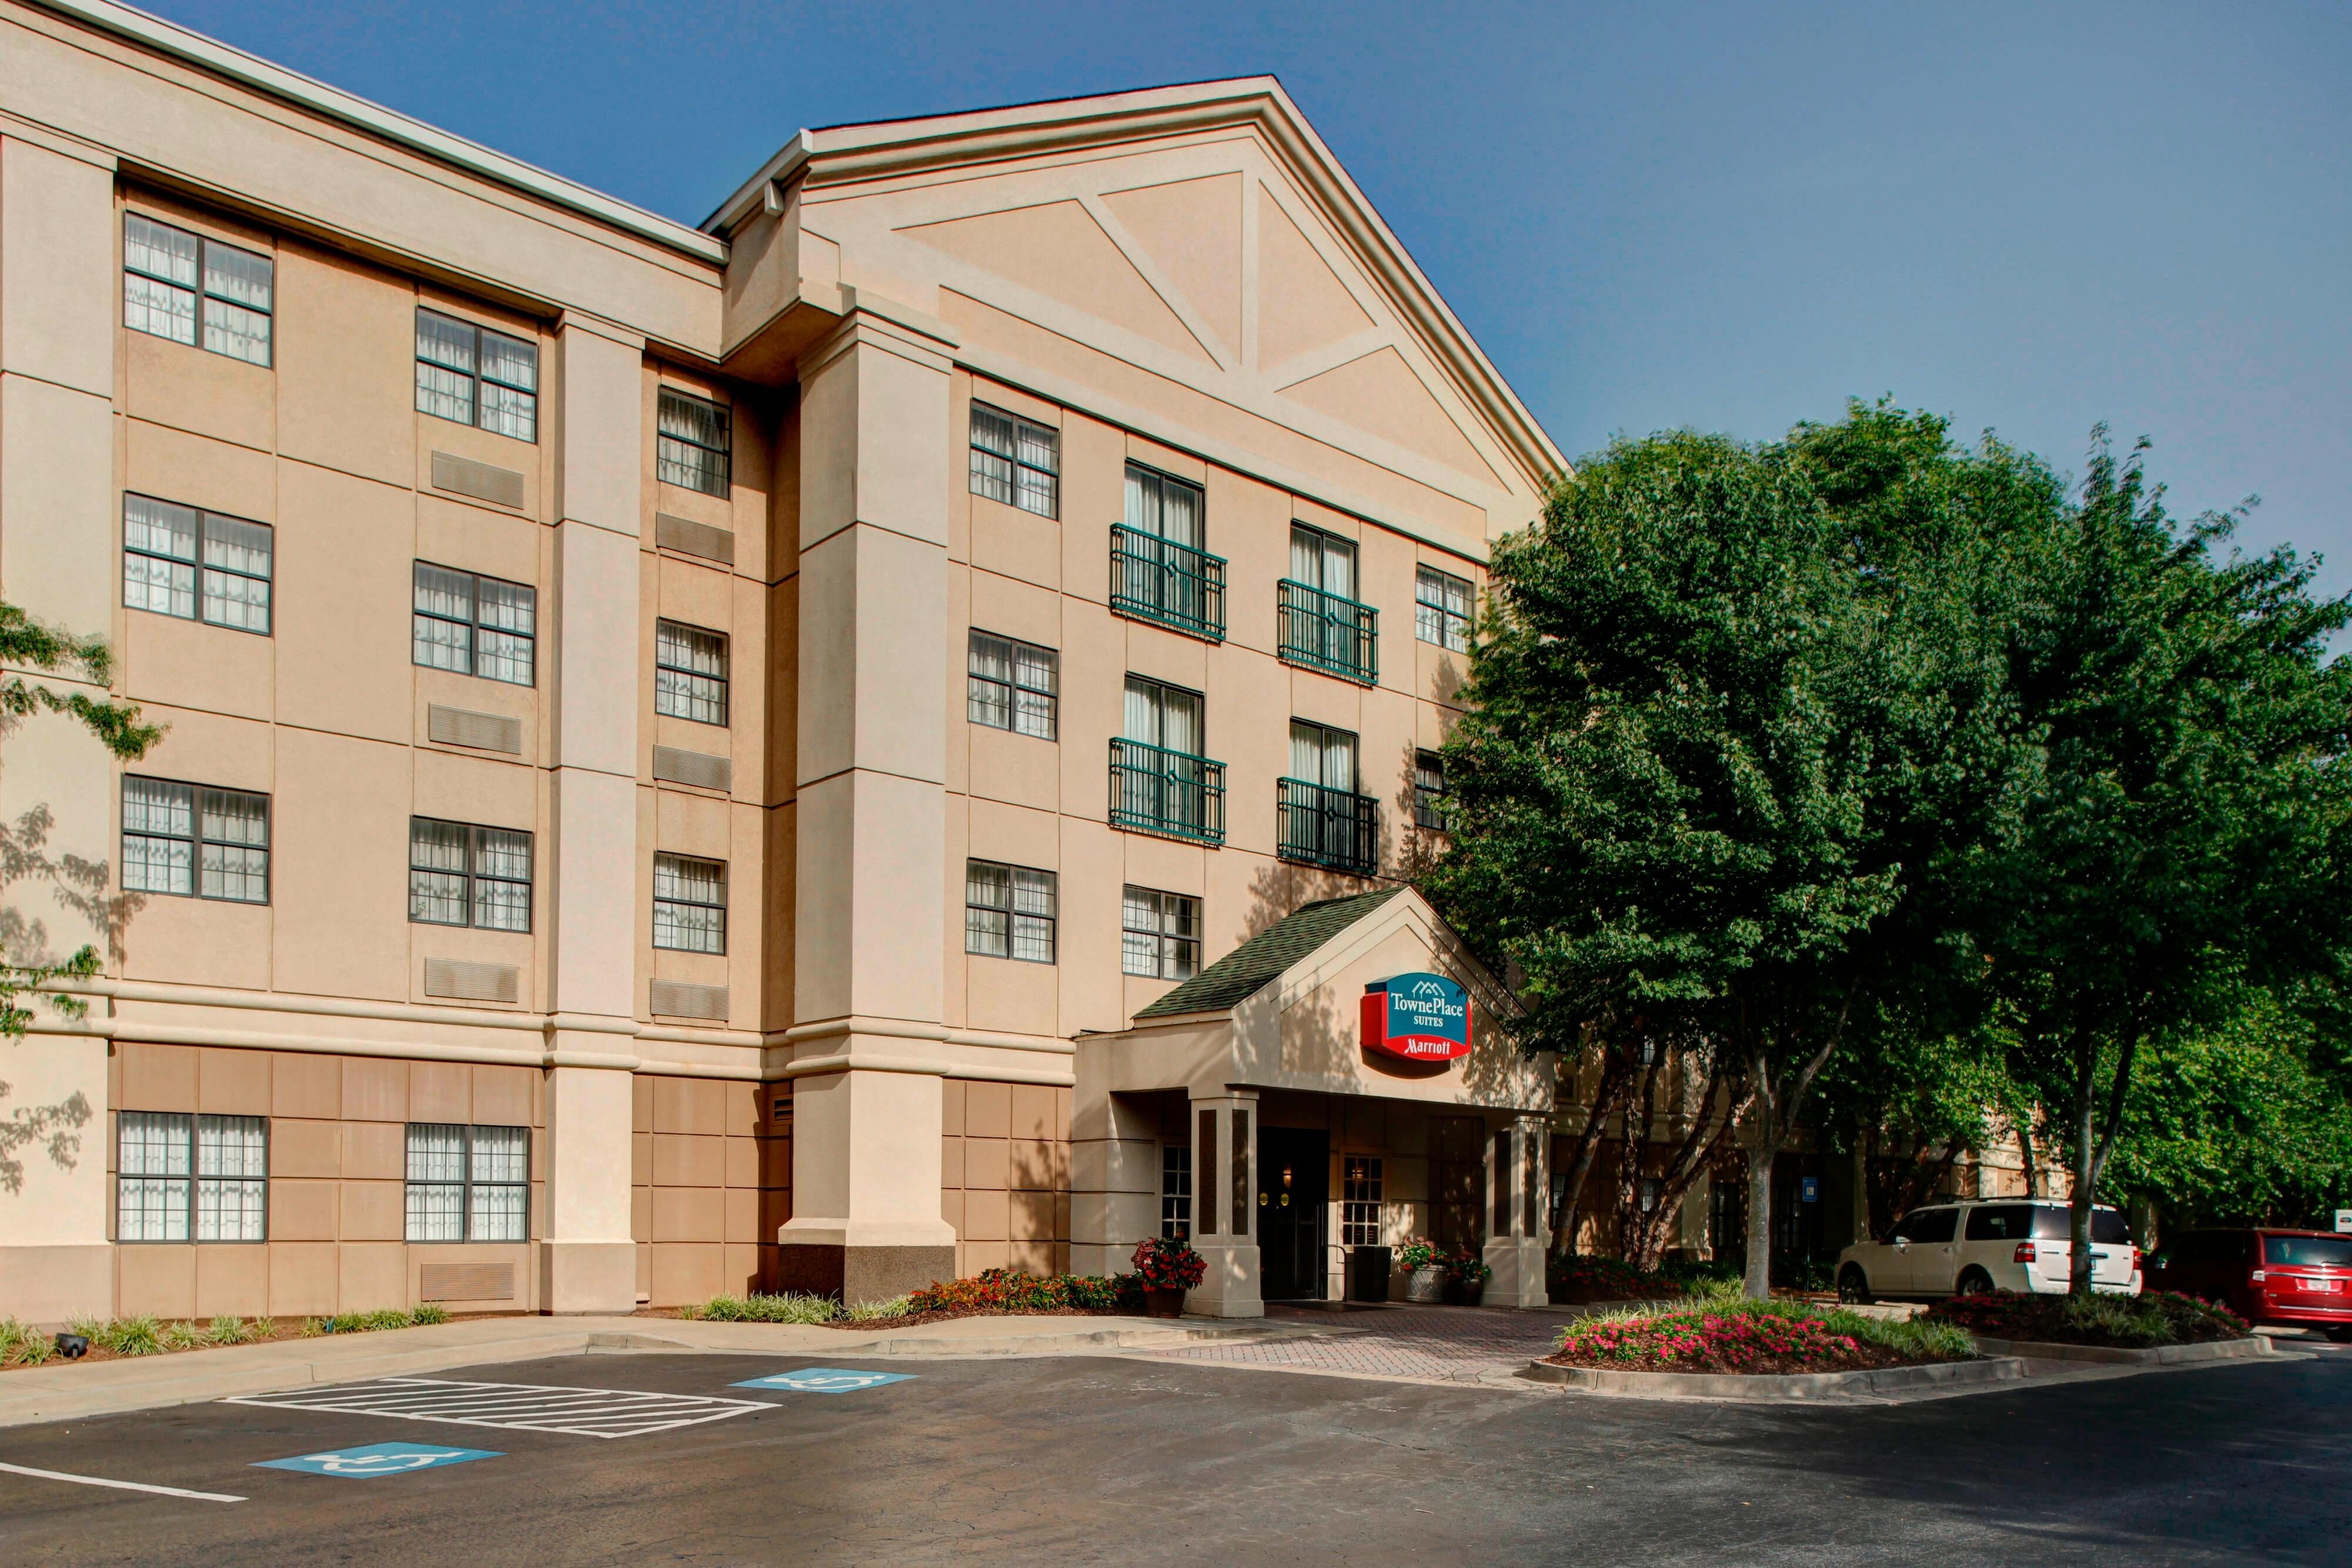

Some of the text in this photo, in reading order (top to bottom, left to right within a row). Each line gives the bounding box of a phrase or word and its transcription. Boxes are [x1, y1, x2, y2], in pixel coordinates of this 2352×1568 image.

[1391, 992, 1463, 1017] TownePlace
[1414, 1015, 1443, 1027] SUITES
[1404, 1038, 1451, 1055] Marriott
